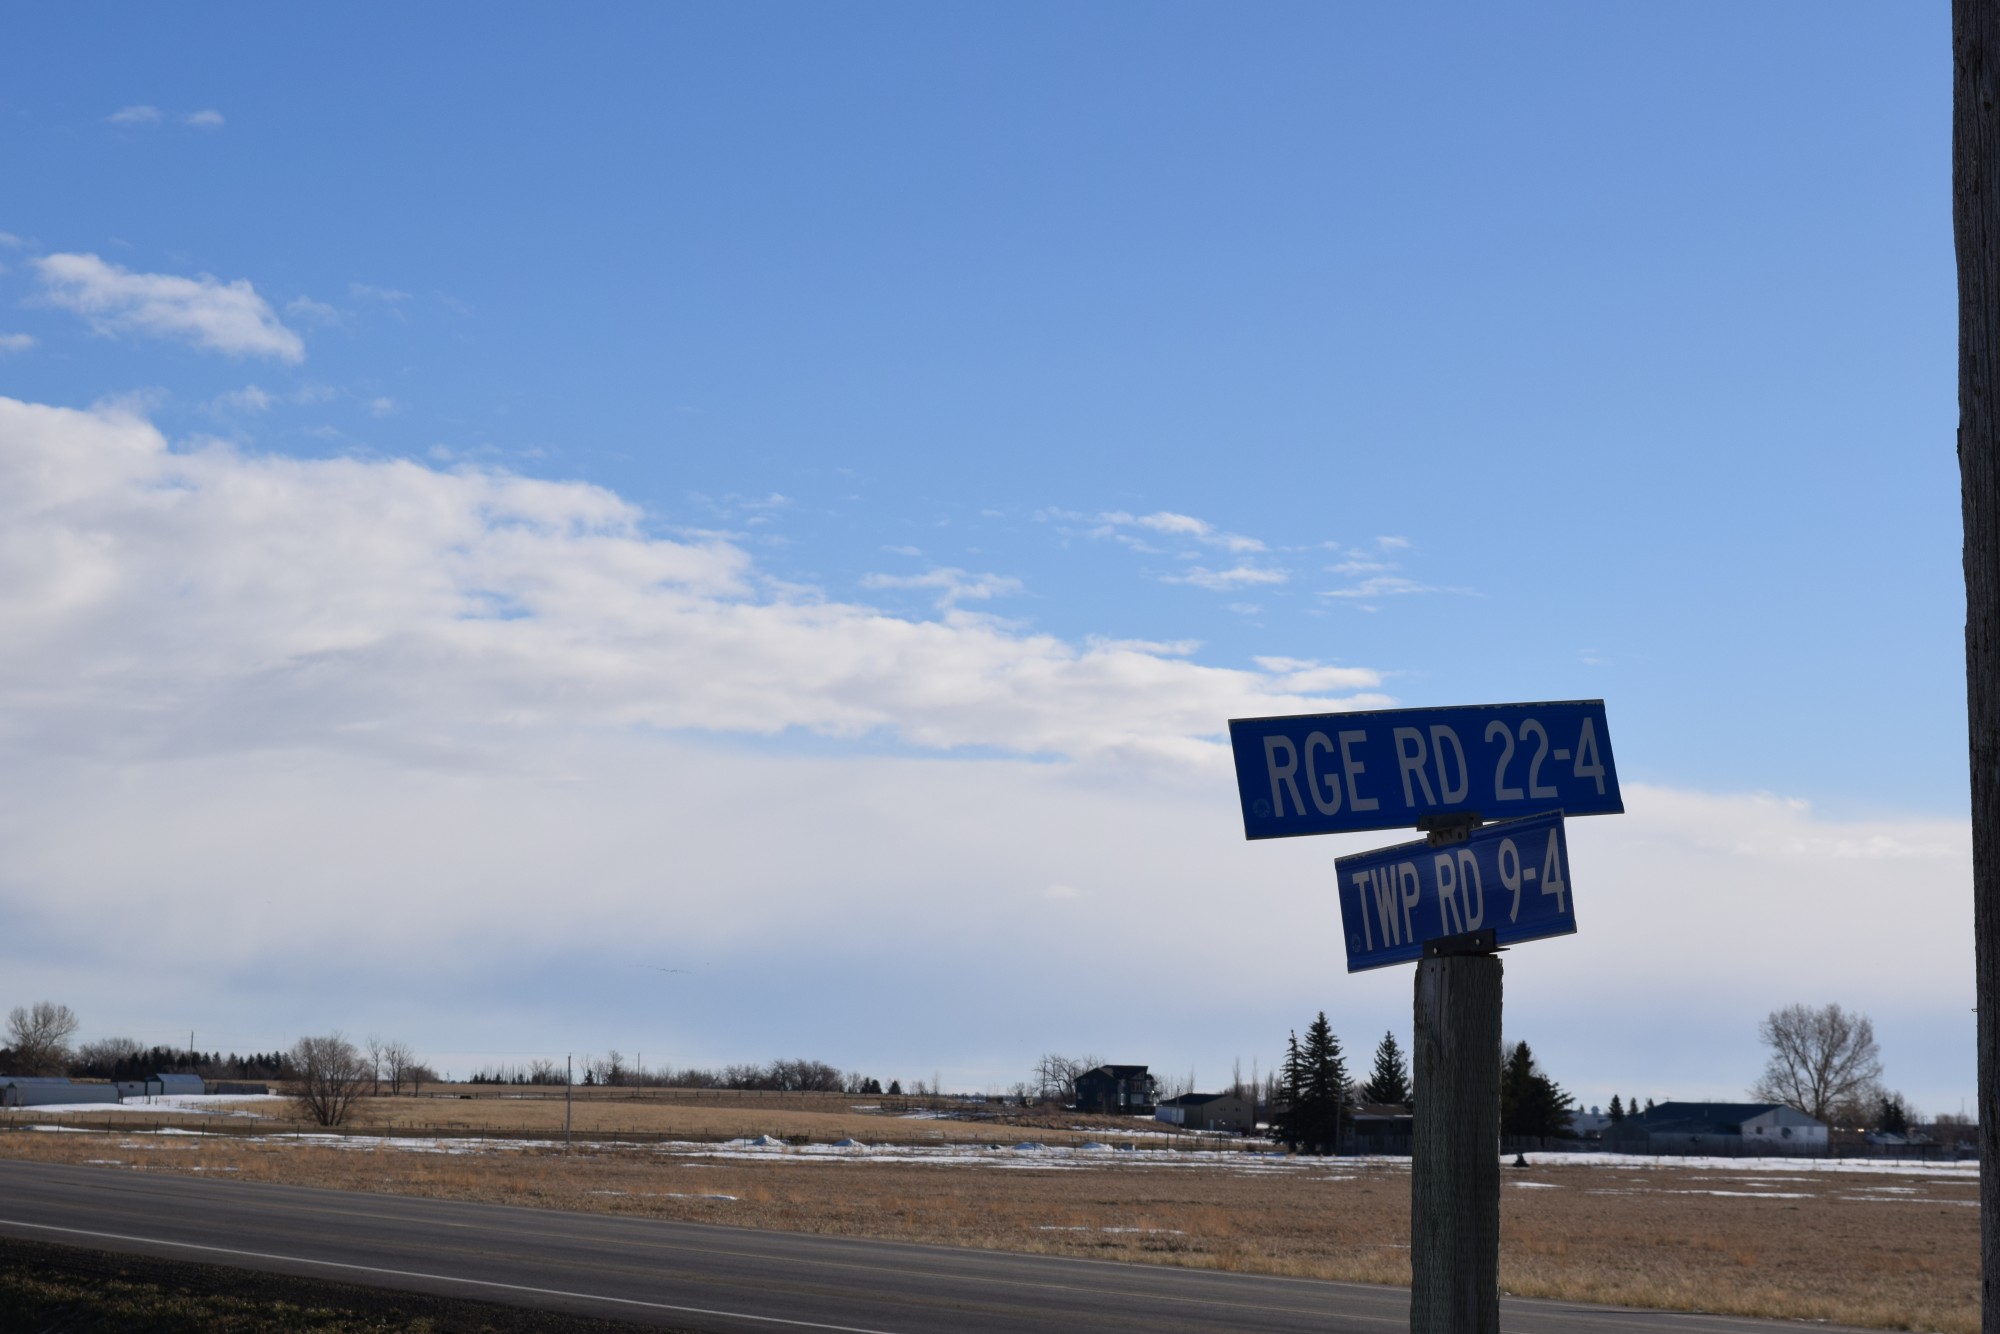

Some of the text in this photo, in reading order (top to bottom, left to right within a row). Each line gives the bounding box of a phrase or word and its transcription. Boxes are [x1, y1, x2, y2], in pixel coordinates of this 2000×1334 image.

[1263, 717, 1606, 818] RGE RD 22-4
[1352, 828, 1566, 951] TWP RD 9-4
